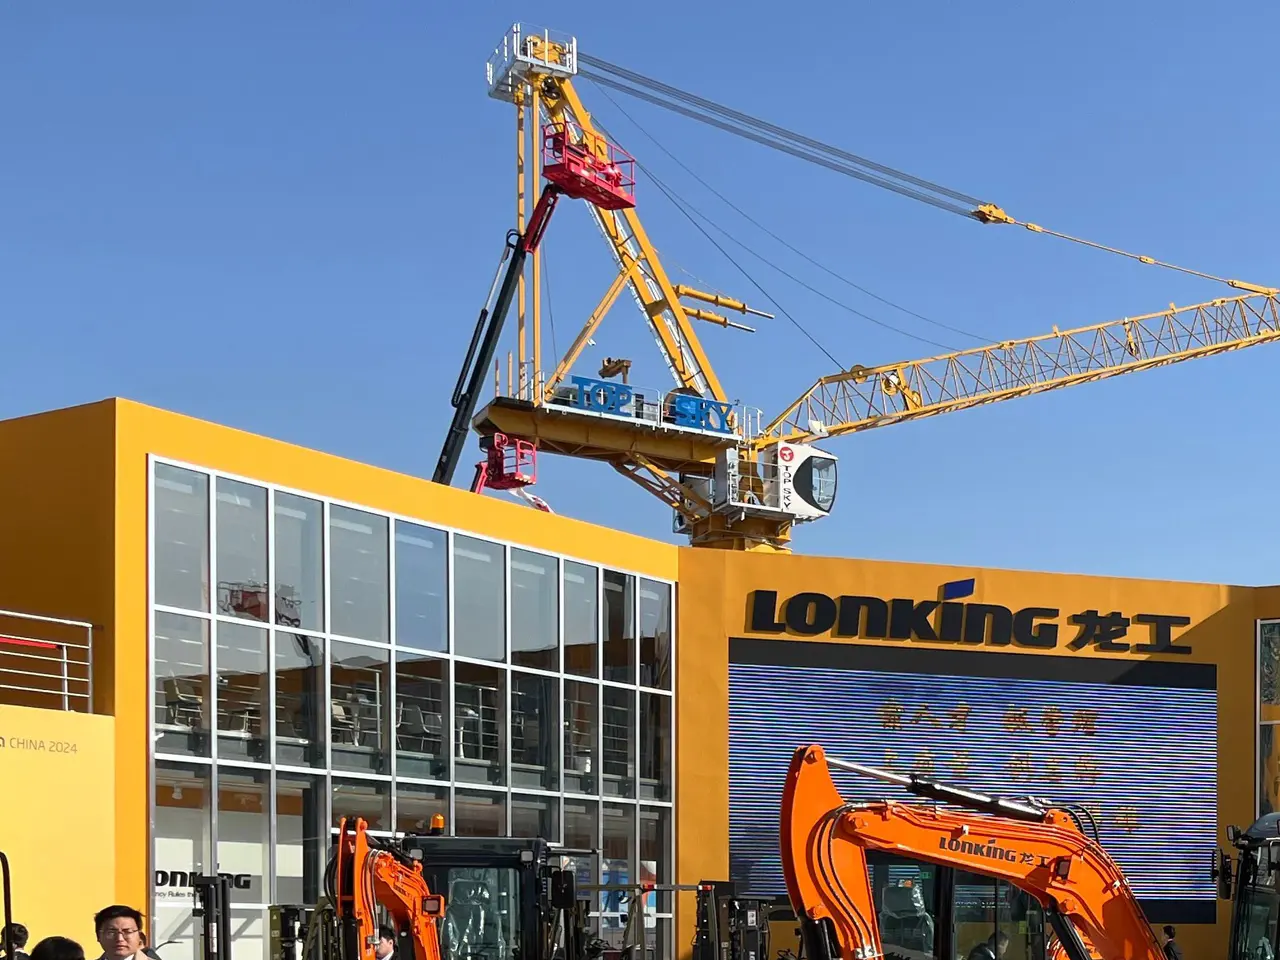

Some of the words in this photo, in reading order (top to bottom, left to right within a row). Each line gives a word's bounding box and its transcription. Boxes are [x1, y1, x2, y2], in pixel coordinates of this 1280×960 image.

[571, 375, 632, 417] TOP
[676, 394, 732, 433] SKY
[782, 465, 792, 484] TOP
[782, 487, 792, 510] SKY
[1066, 609, 1192, 655] 龙工
[9, 736, 46, 751] CHINA
[48, 740, 78, 754] 2024
